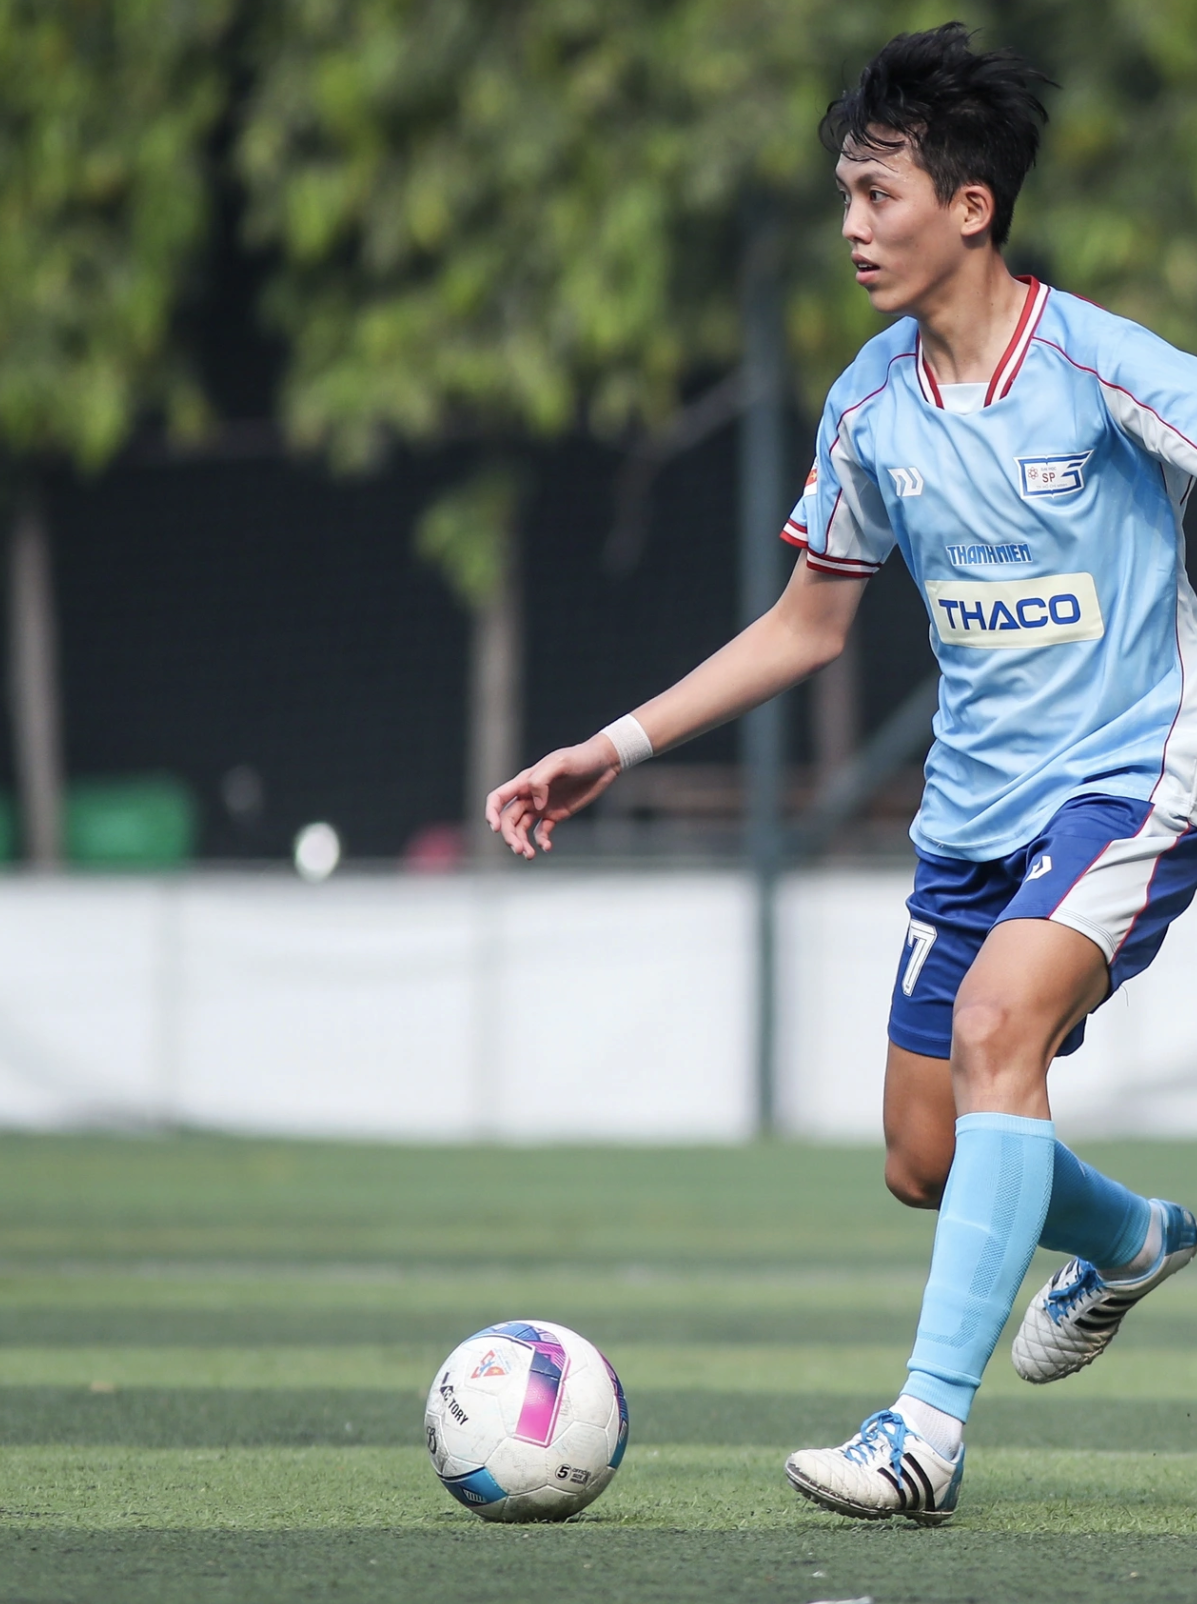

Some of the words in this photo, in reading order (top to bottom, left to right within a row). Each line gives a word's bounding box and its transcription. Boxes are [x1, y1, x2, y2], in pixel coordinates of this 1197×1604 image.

[1042, 472, 1056, 483] SP
[938, 593, 1081, 630] THACO
[902, 919, 938, 997] 7
[557, 1466, 570, 1479] 5
